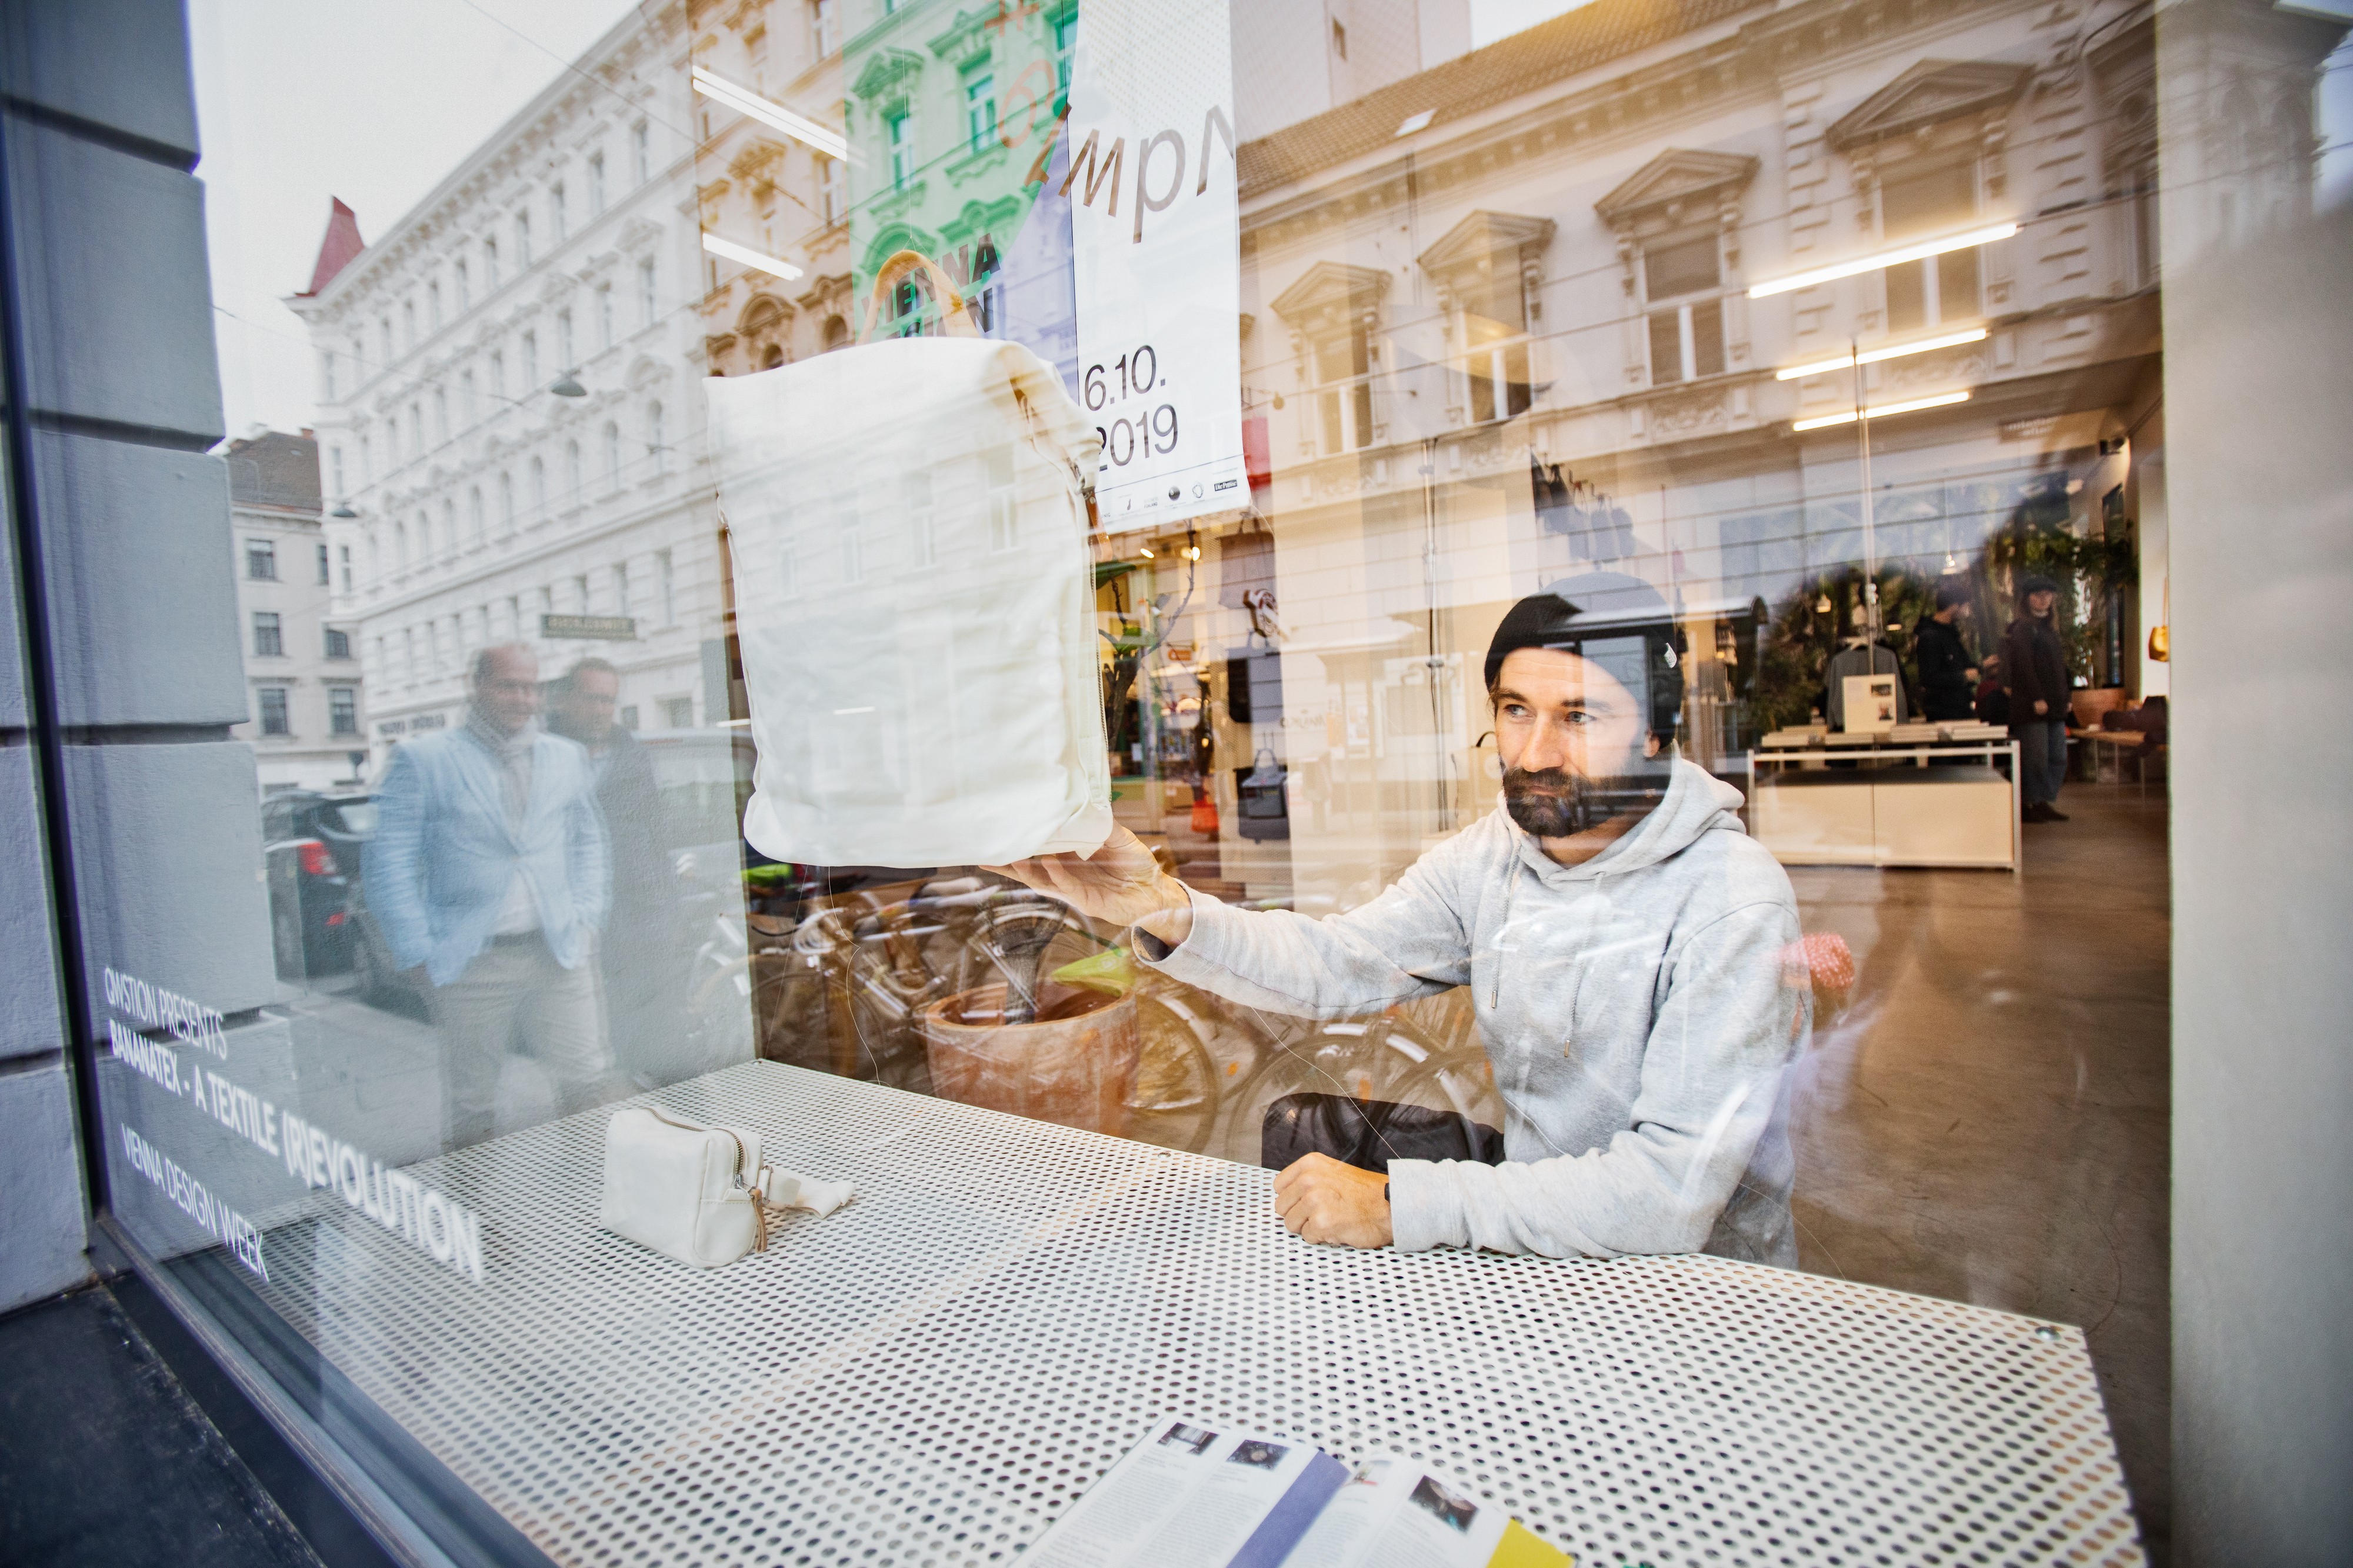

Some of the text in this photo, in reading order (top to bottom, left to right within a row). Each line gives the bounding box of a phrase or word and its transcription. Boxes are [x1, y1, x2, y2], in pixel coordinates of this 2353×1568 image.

[1084, 345, 1166, 411] 6.10.
[105, 966, 228, 1060] QWSTION PRESENTS
[109, 1018, 182, 1096] BANANATEX
[195, 1065, 208, 1113] A
[207, 1071, 279, 1157] TEXTILE
[282, 1110, 481, 1283] (R)EVOLUTION
[121, 1121, 270, 1283] VIENNA DESIGN WEEK
